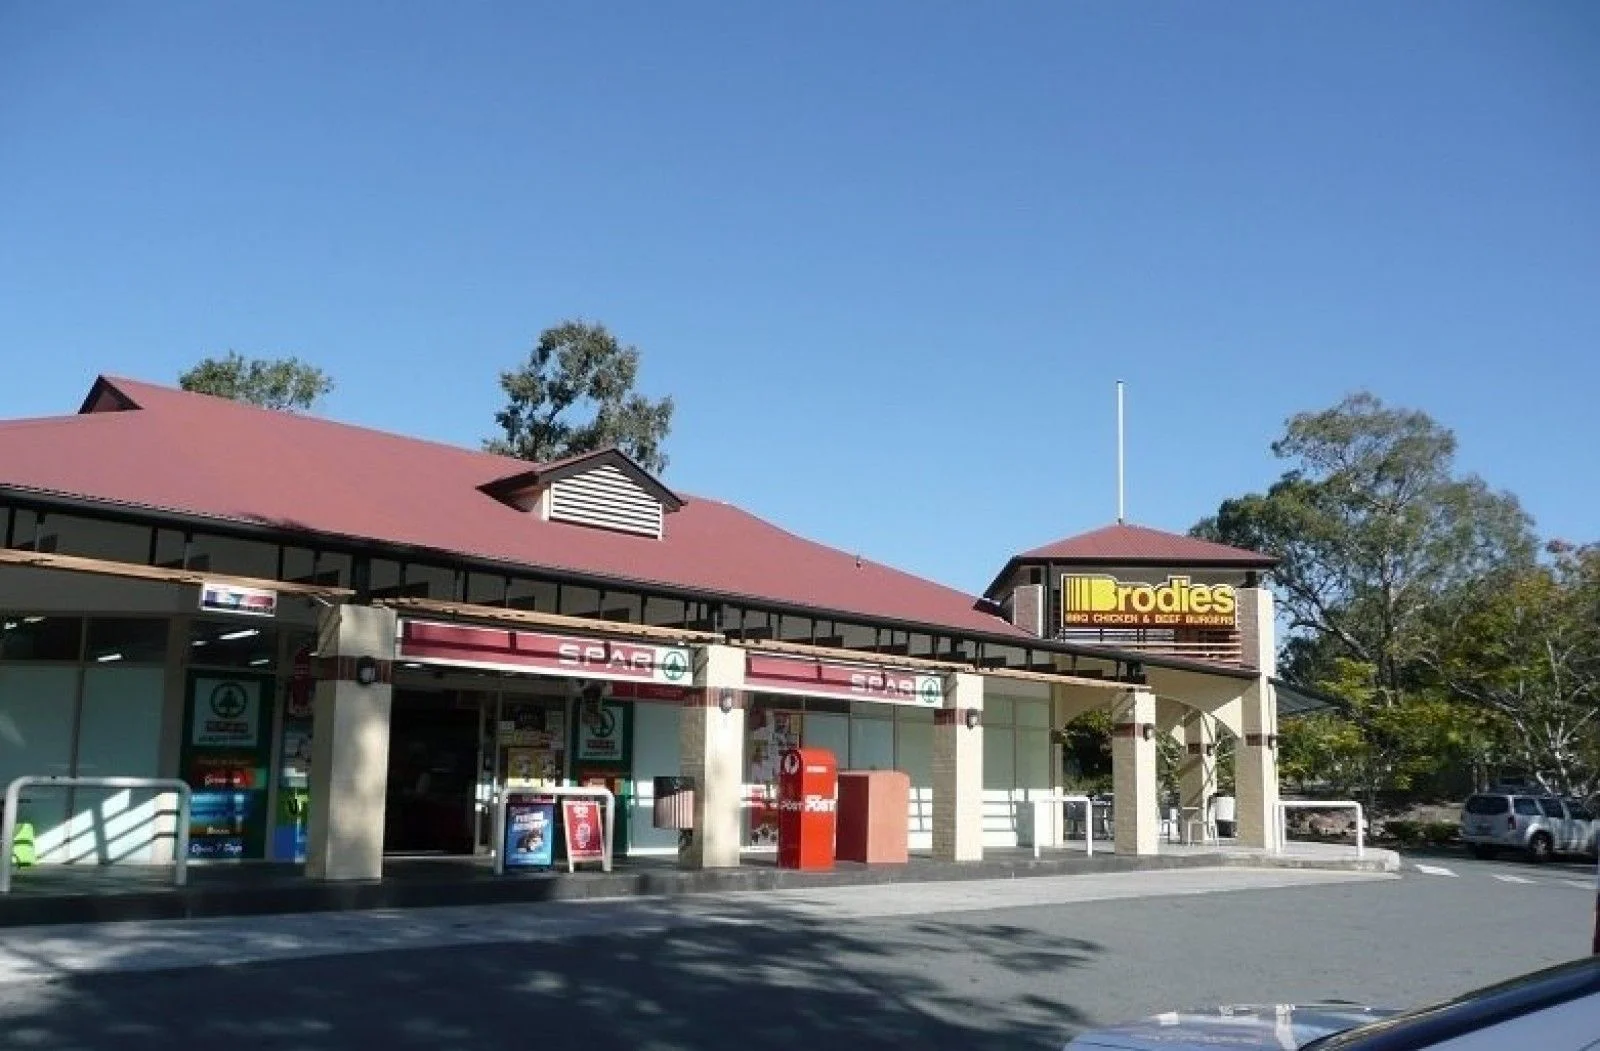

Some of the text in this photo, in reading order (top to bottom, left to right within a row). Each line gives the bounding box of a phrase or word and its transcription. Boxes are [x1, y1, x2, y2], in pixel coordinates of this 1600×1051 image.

[1065, 576, 1235, 613] Brodies
[1093, 614, 1138, 625] CHICKEN
[1143, 615, 1150, 625] &
[1155, 614, 1181, 625] BEEF
[1185, 614, 1234, 626] BURGERS
[558, 643, 652, 673] SPAR
[851, 673, 914, 697] SPAR
[804, 798, 837, 812] POST
